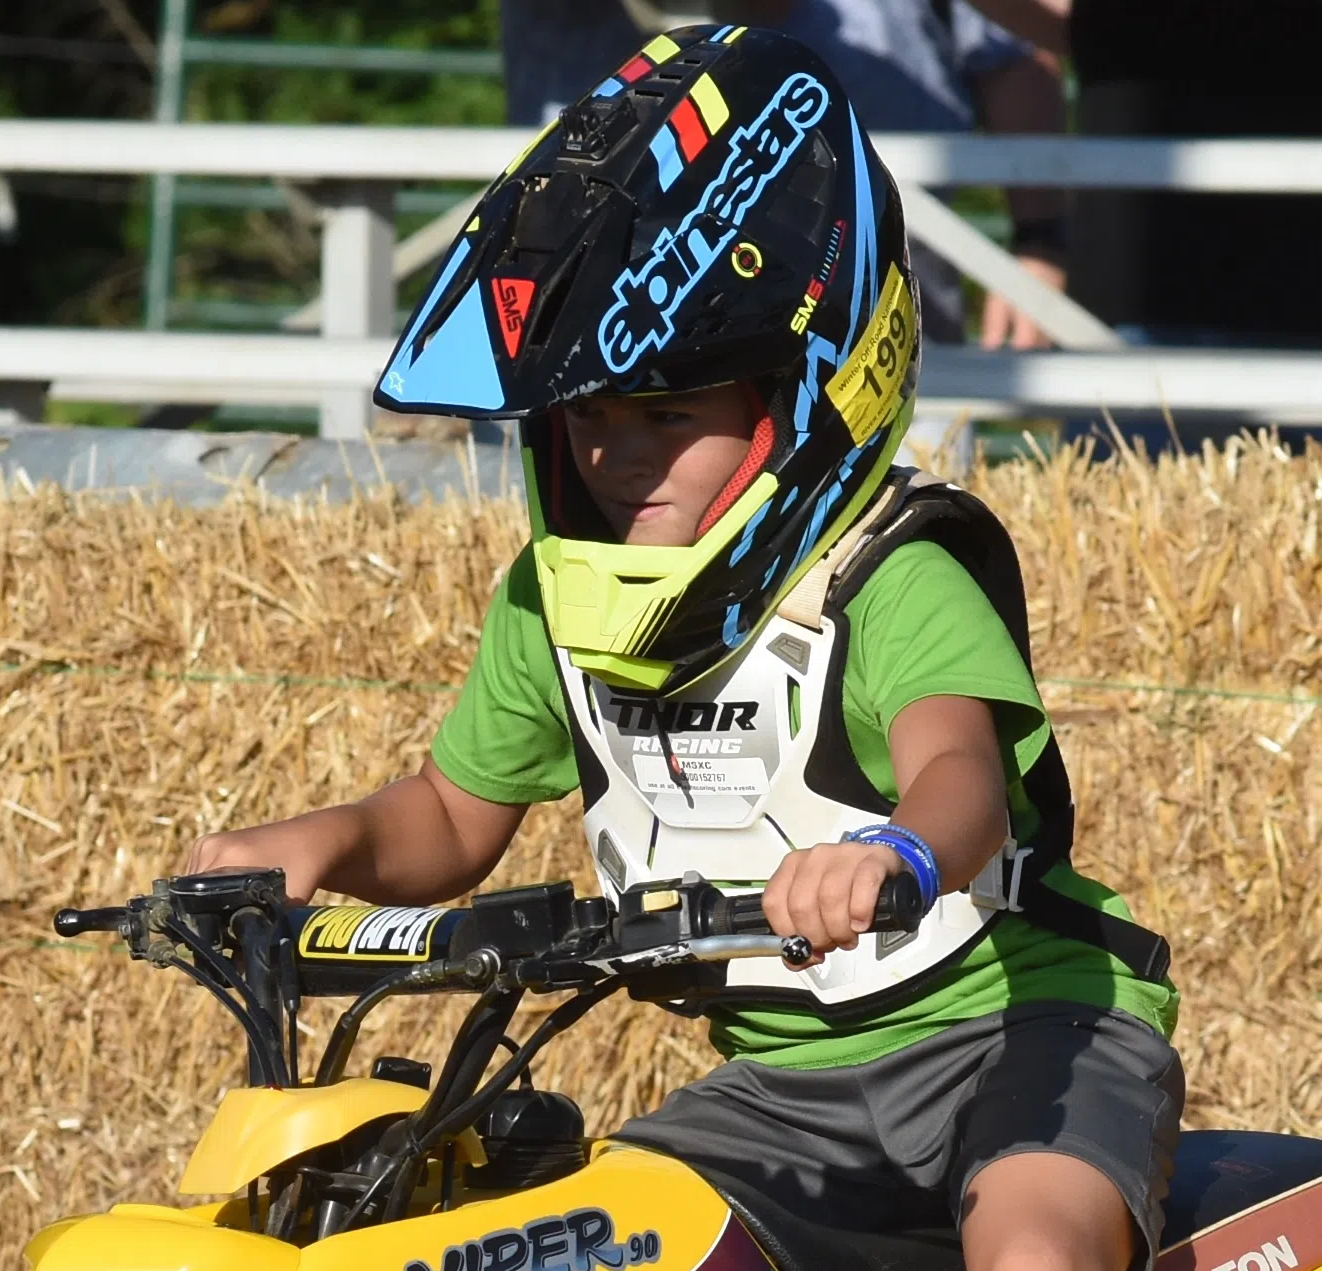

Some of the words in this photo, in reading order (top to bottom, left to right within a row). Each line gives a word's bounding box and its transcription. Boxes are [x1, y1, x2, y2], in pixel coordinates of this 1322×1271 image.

[790, 274, 825, 336] SM5
[860, 307, 907, 400] 199
[837, 360, 863, 393] Winter
[609, 697, 760, 732] THOR
[632, 736, 743, 755] RACING
[630, 1232, 660, 1263] 90
